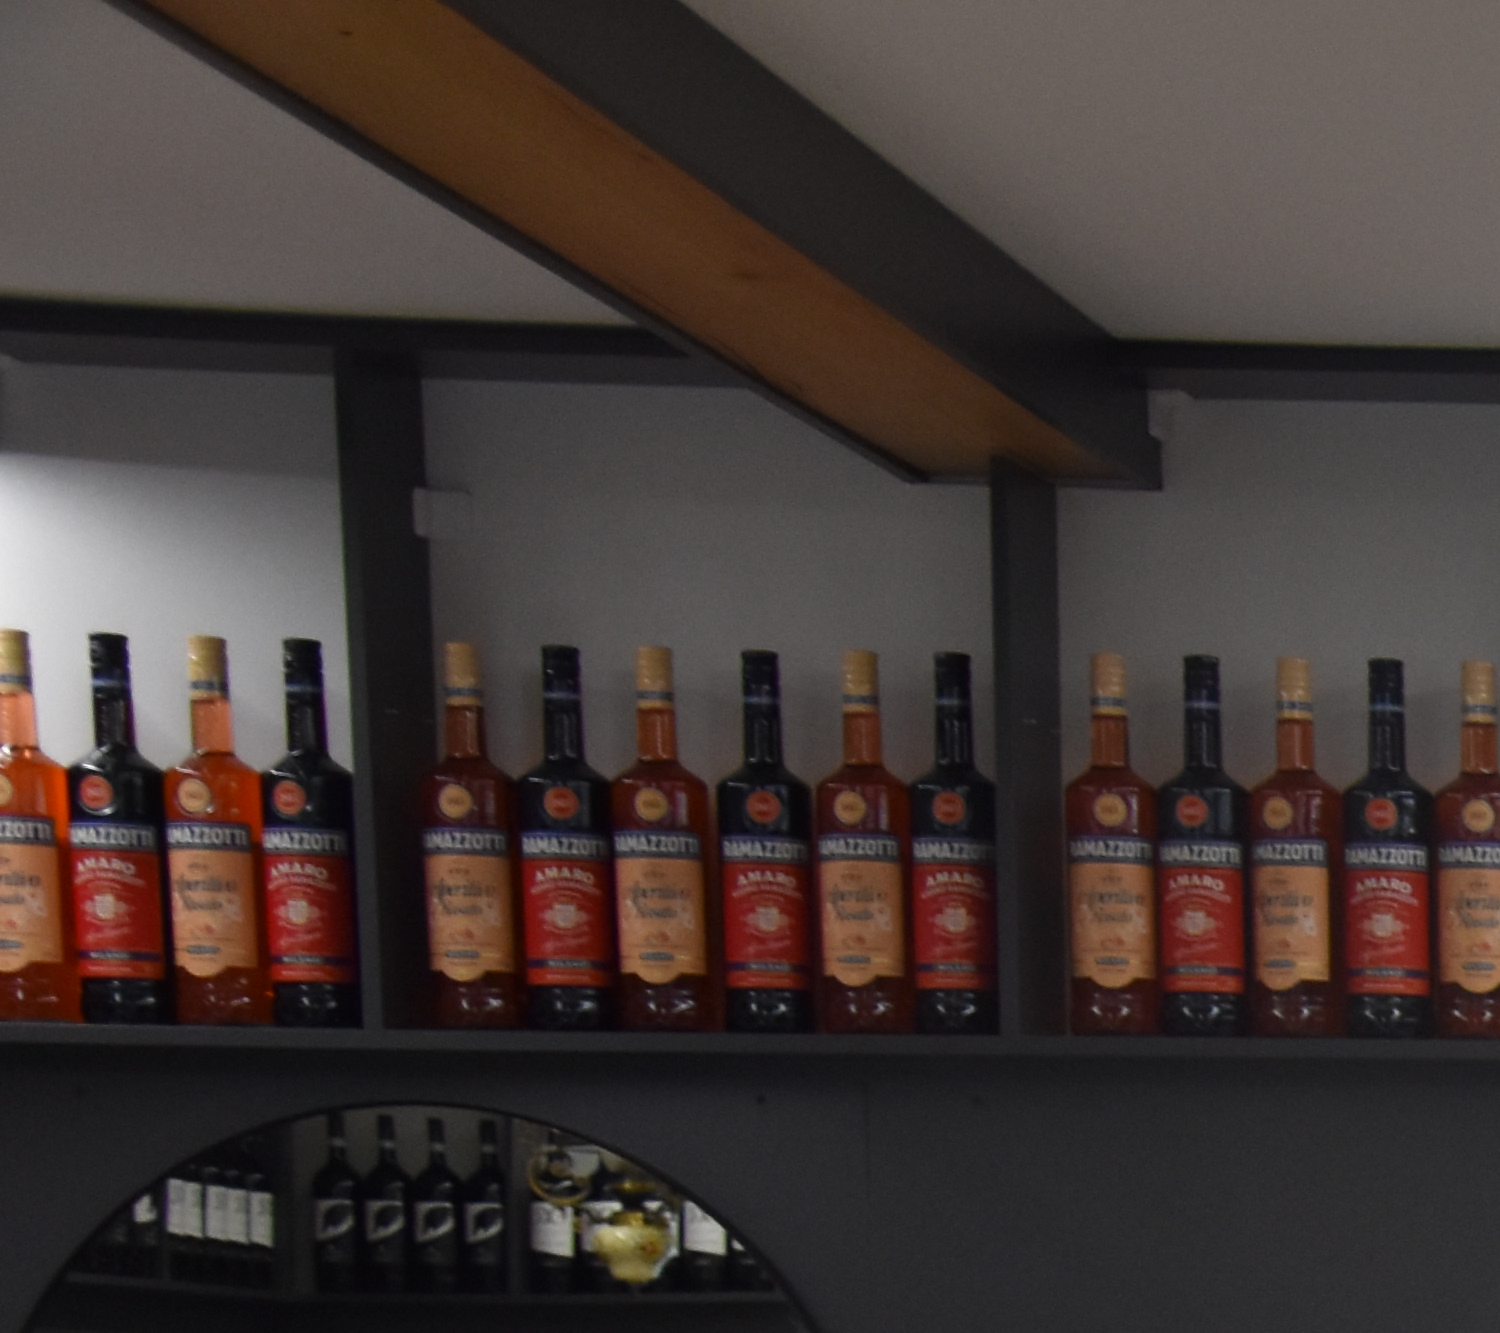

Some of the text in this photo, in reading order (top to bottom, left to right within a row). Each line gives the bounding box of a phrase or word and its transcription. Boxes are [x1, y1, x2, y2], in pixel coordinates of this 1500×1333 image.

[76, 857, 138, 876] AMARO
[271, 862, 329, 880] AMARO
[533, 866, 595, 885] AMARO
[737, 870, 797, 887] AMARO
[925, 871, 986, 888] AMARO
[1168, 874, 1227, 891] AMARO
[1356, 877, 1414, 895] AMARO
